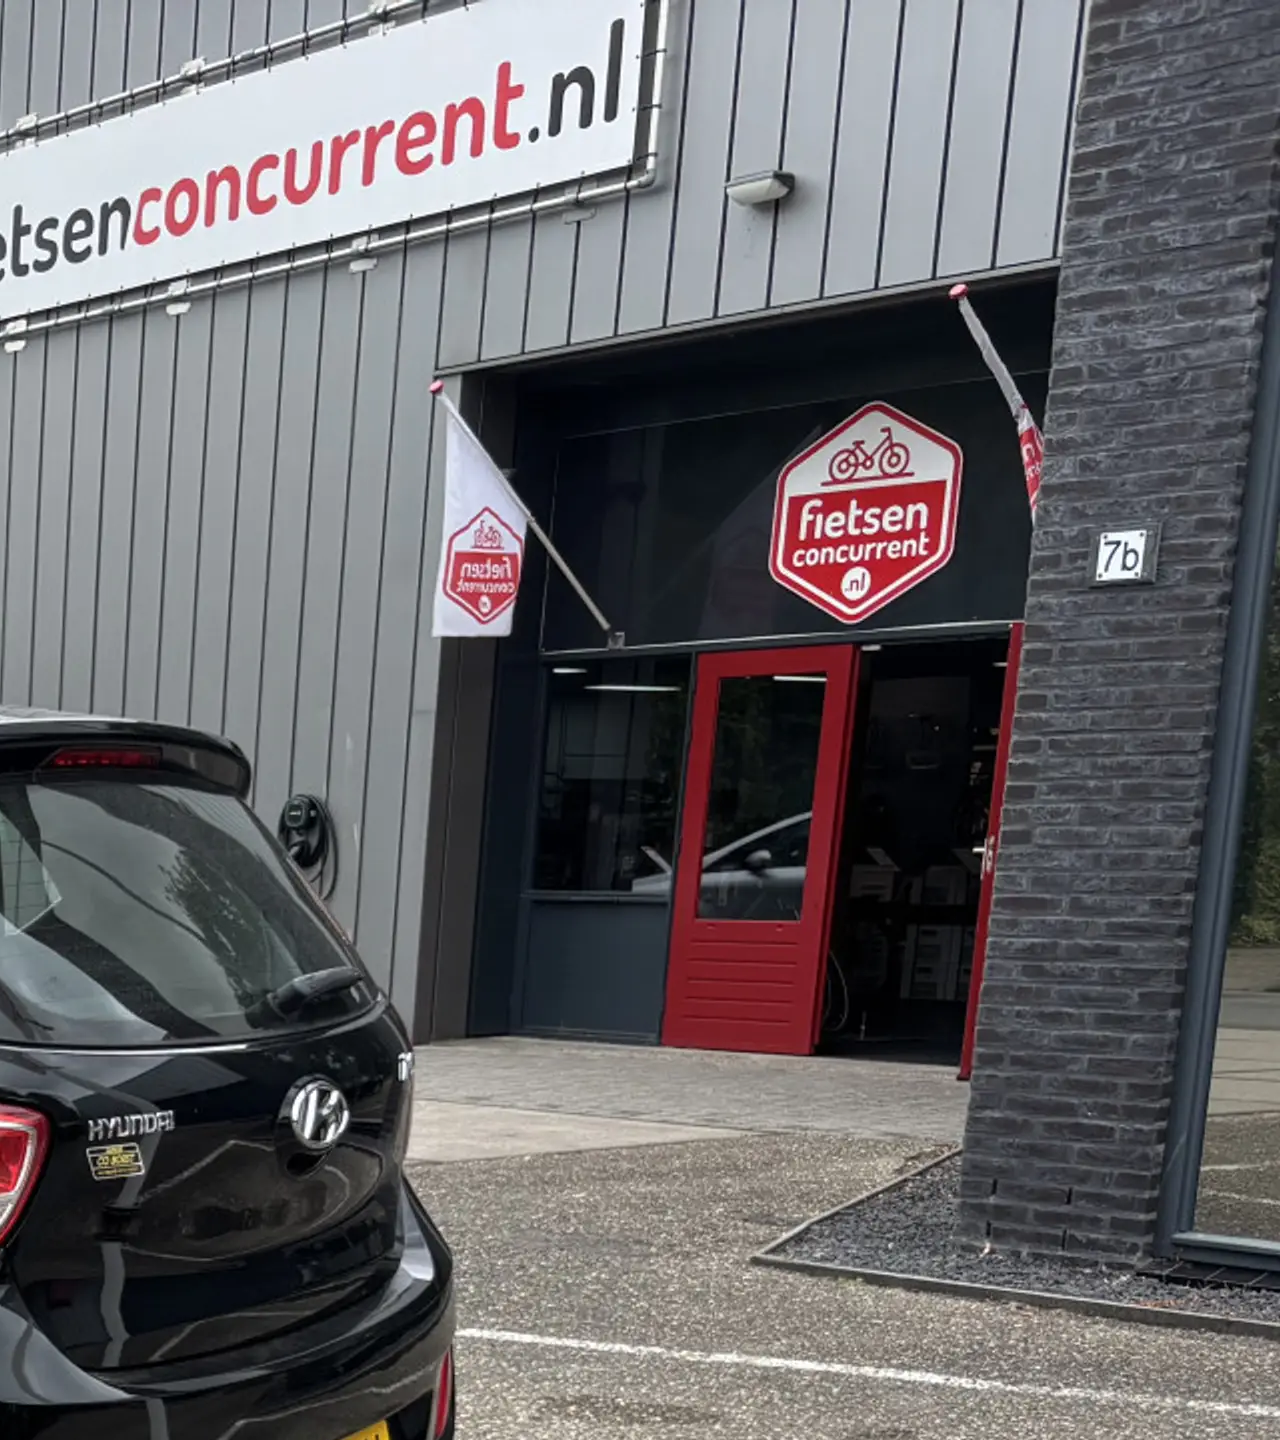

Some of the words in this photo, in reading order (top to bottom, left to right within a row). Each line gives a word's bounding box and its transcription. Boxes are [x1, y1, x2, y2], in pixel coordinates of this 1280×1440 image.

[798, 498, 929, 541] fietsen
[792, 530, 930, 567] concurrent
[1104, 540, 1139, 573] 7b
[844, 571, 866, 592] .nl
[88, 1109, 176, 1142] HYUNDAI
